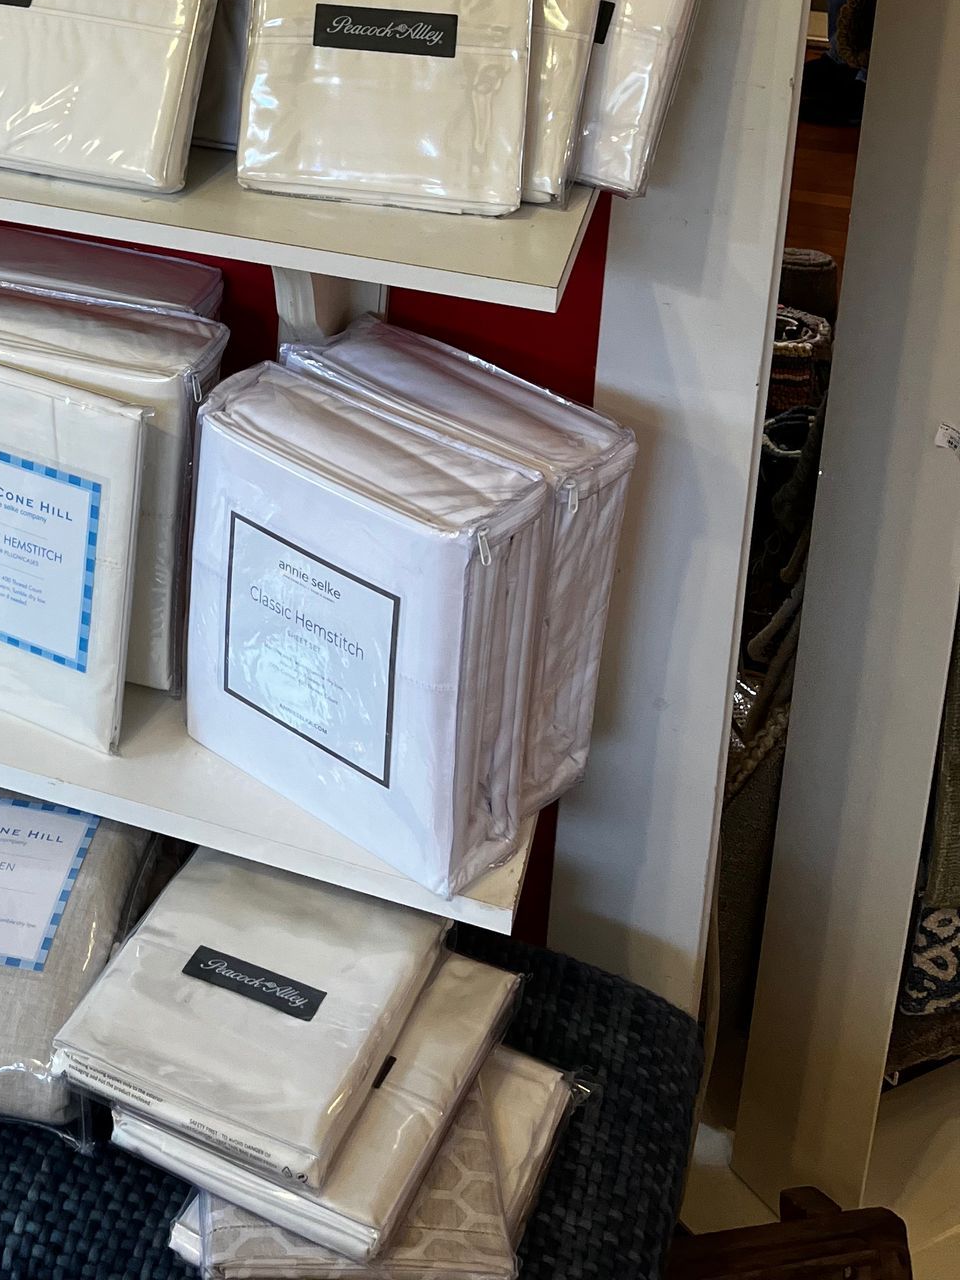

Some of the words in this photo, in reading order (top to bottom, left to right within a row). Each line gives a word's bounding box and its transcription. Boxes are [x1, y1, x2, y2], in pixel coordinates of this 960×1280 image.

[326, 15, 394, 37] Peacock
[396, 22, 444, 46] Alley
[20, 508, 47, 524] company
[40, 501, 73, 521] HILL
[4, 535, 63, 564] HEMSTITCH
[279, 559, 309, 583] annie
[311, 576, 341, 600] selke
[250, 585, 292, 620] Classic
[295, 610, 365, 661] Hemstitch
[27, 830, 64, 843] HILL
[200, 959, 264, 988] Peacock
[262, 986, 308, 1007] Alley
